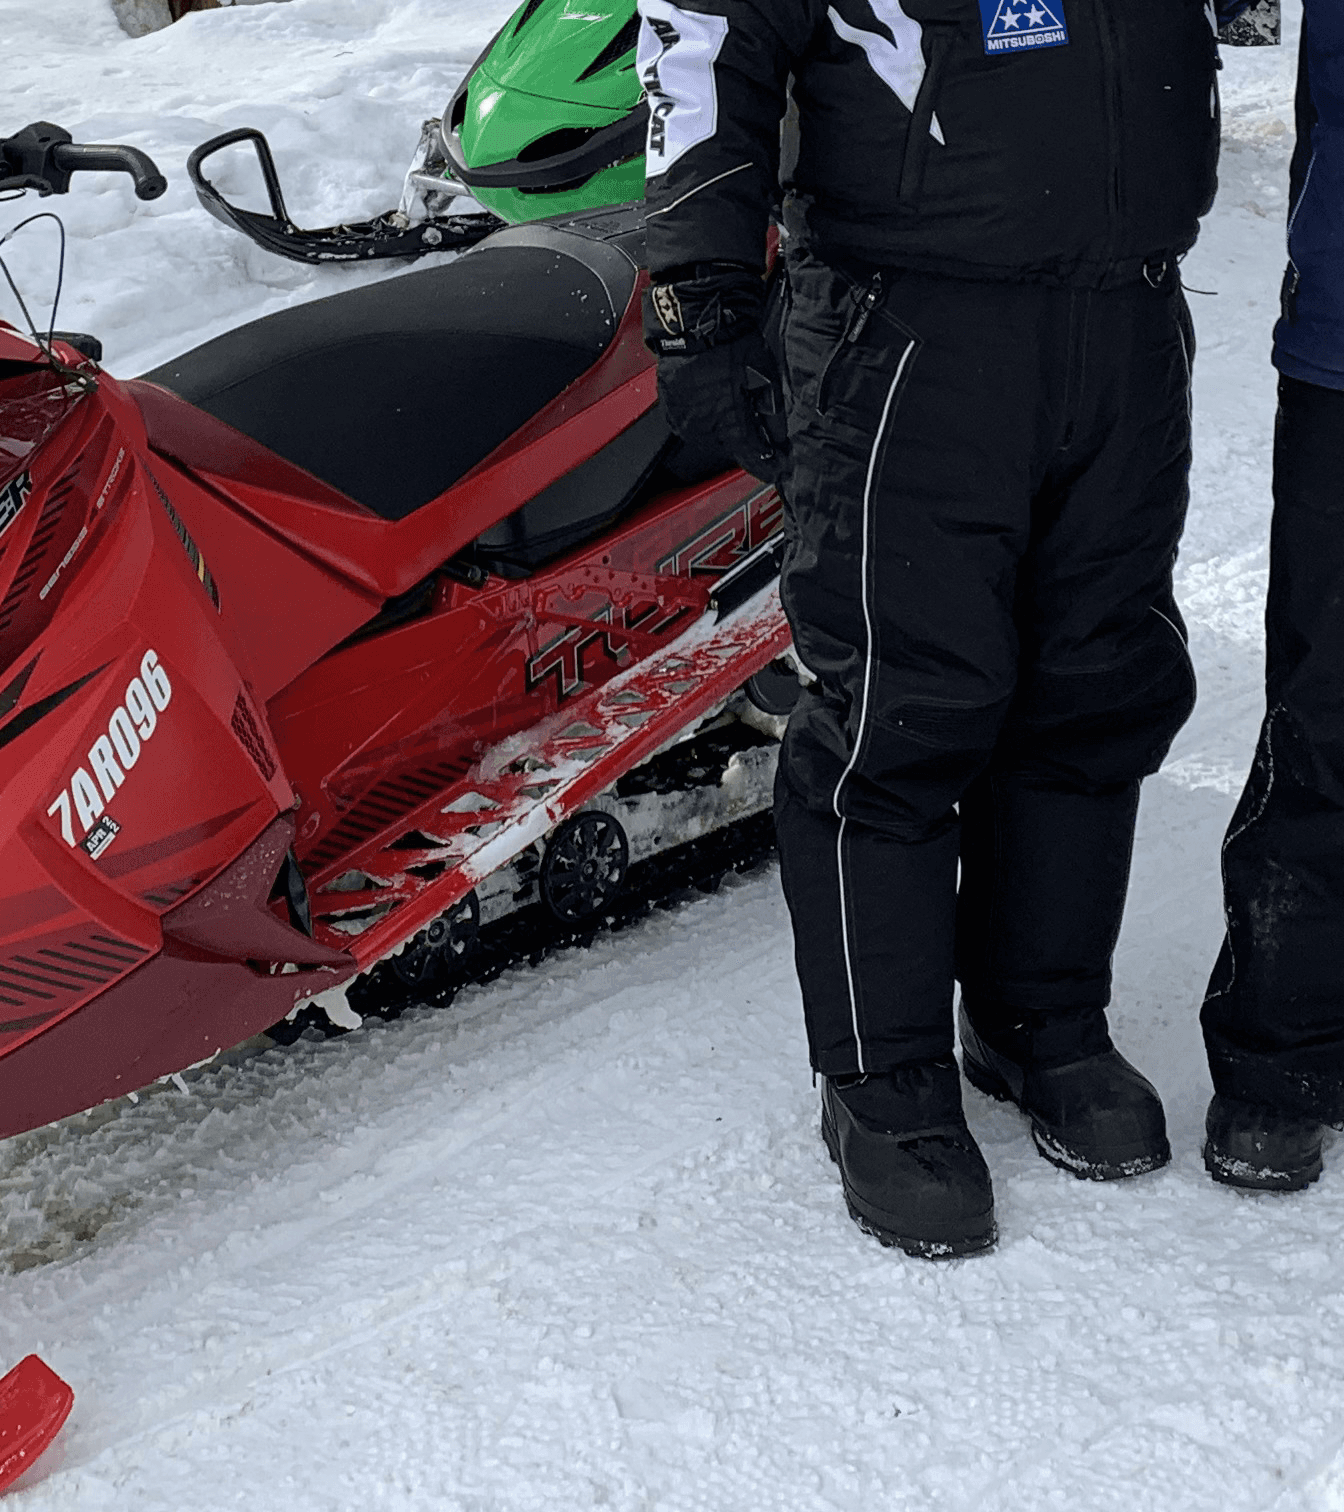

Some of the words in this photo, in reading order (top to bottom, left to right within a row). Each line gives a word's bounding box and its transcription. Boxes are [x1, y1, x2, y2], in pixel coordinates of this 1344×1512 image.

[986, 30, 1066, 51] MITSUBOSHI
[649, 101, 677, 158] CAT
[46, 647, 173, 849] 7AR096
[86, 827, 108, 853] APR
